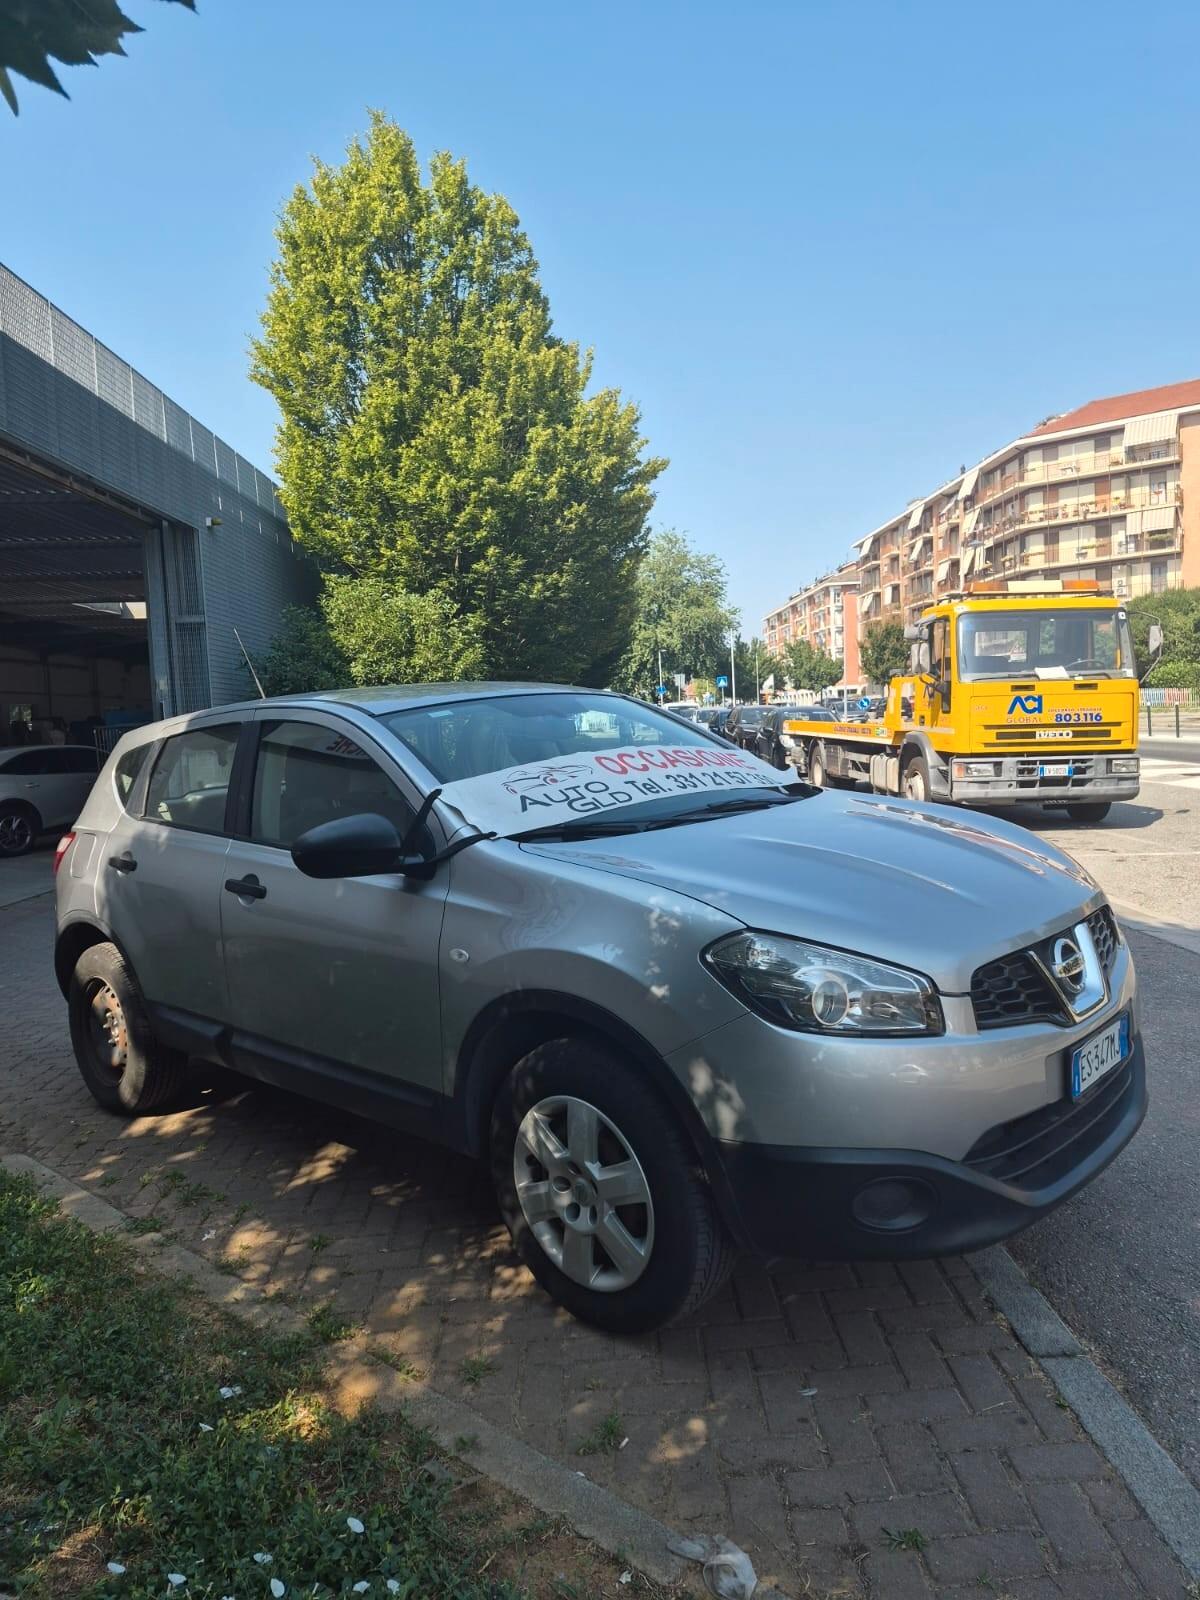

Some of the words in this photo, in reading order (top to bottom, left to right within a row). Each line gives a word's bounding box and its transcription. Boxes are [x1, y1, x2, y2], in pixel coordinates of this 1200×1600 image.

[1006, 716, 1042, 724] GLOBAL
[594, 749, 757, 775] OCCASIONE
[623, 777, 672, 796] Tel.
[667, 772, 708, 792] 331
[701, 771, 733, 786] 21
[519, 781, 610, 813] AUTO
[567, 791, 633, 812] GLD
